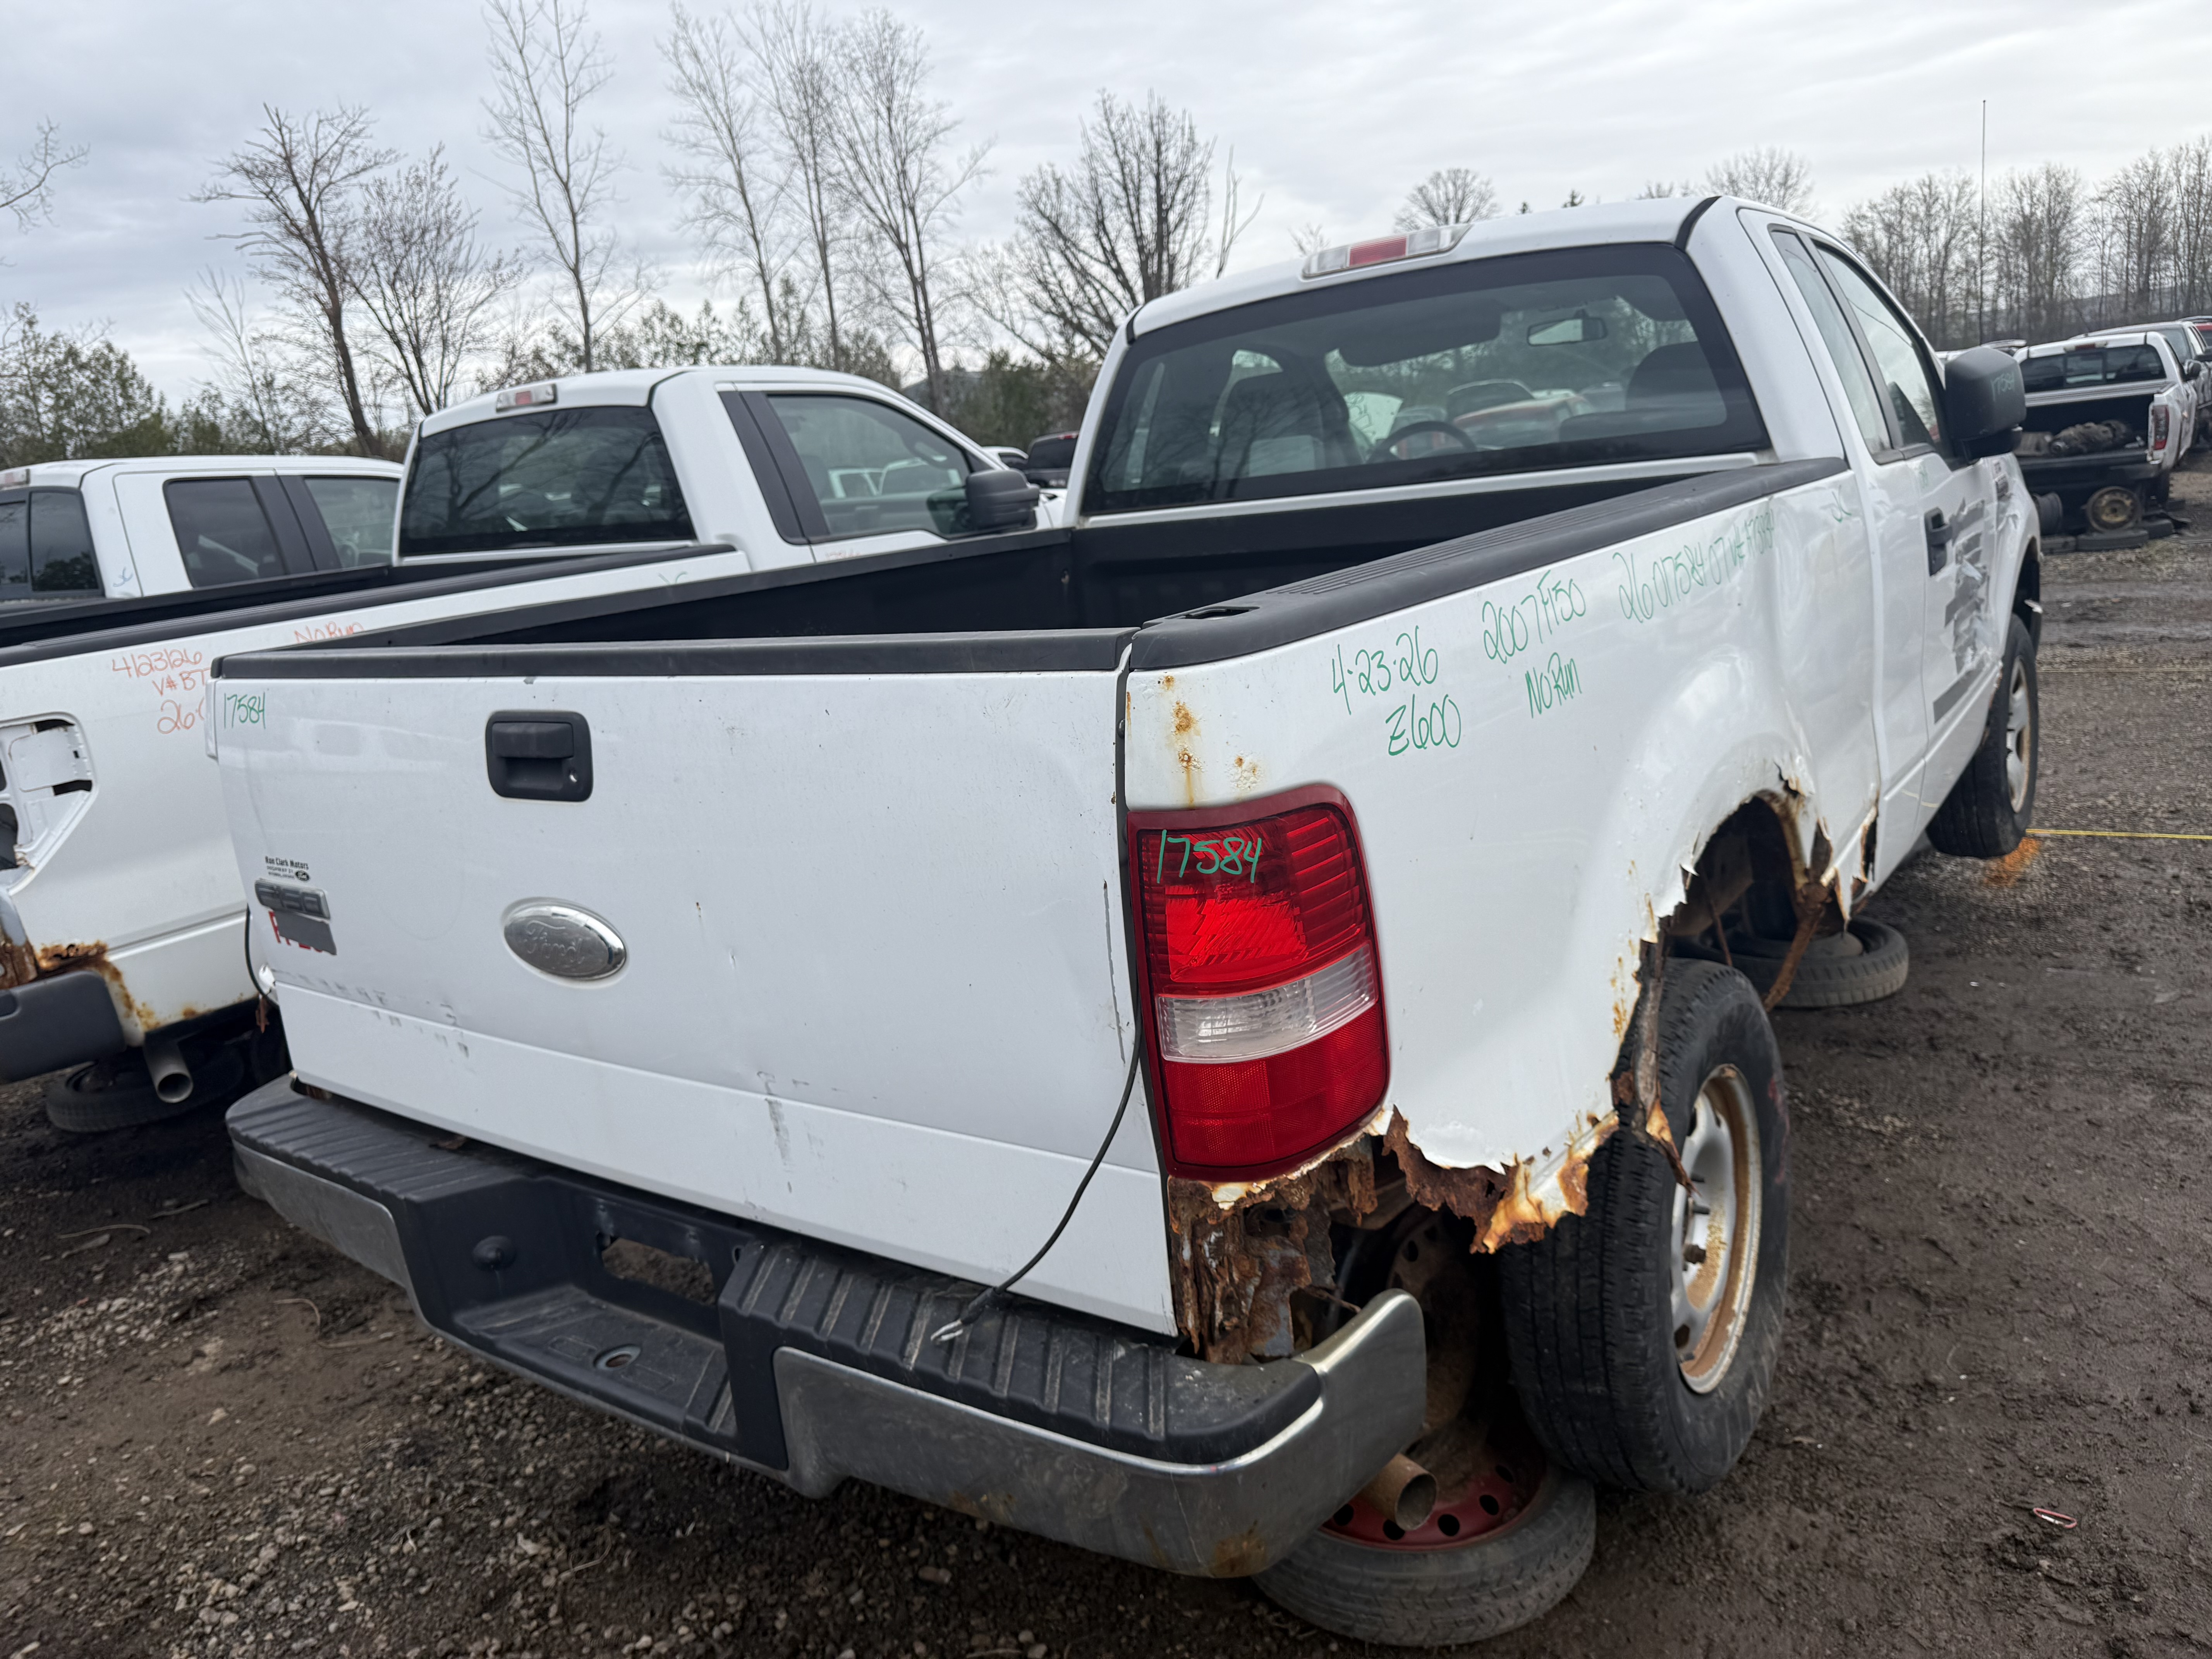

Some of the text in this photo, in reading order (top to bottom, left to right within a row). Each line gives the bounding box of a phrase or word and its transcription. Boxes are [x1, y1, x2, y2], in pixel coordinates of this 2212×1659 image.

[1482, 570, 1586, 665] 2007 F150
[224, 692, 266, 730] 17584
[290, 859, 309, 871] Motors
[1156, 829, 1262, 883] 17584
